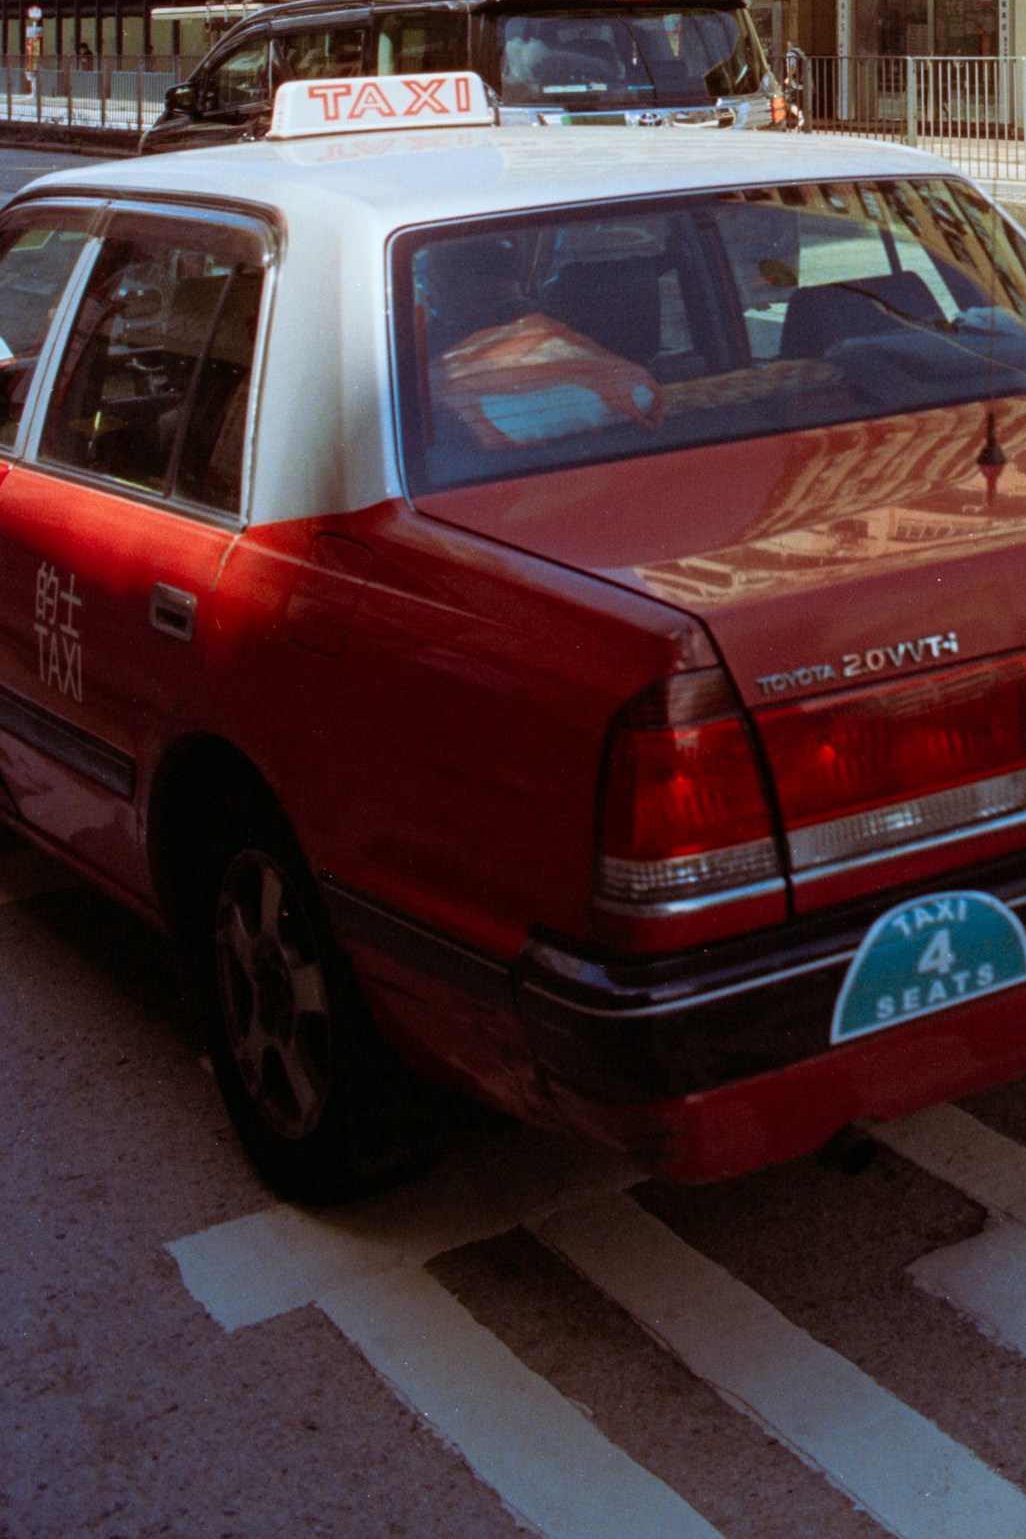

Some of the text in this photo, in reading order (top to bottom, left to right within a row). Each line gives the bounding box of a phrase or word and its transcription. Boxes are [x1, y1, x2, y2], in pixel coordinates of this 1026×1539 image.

[307, 77, 472, 121] TAXI
[35, 561, 82, 639] 的士
[34, 623, 83, 703] TAXI
[757, 664, 837, 695] TOYOTA
[892, 898, 967, 937] TAXI
[917, 927, 956, 975] 4
[875, 962, 995, 1020] SEATS
